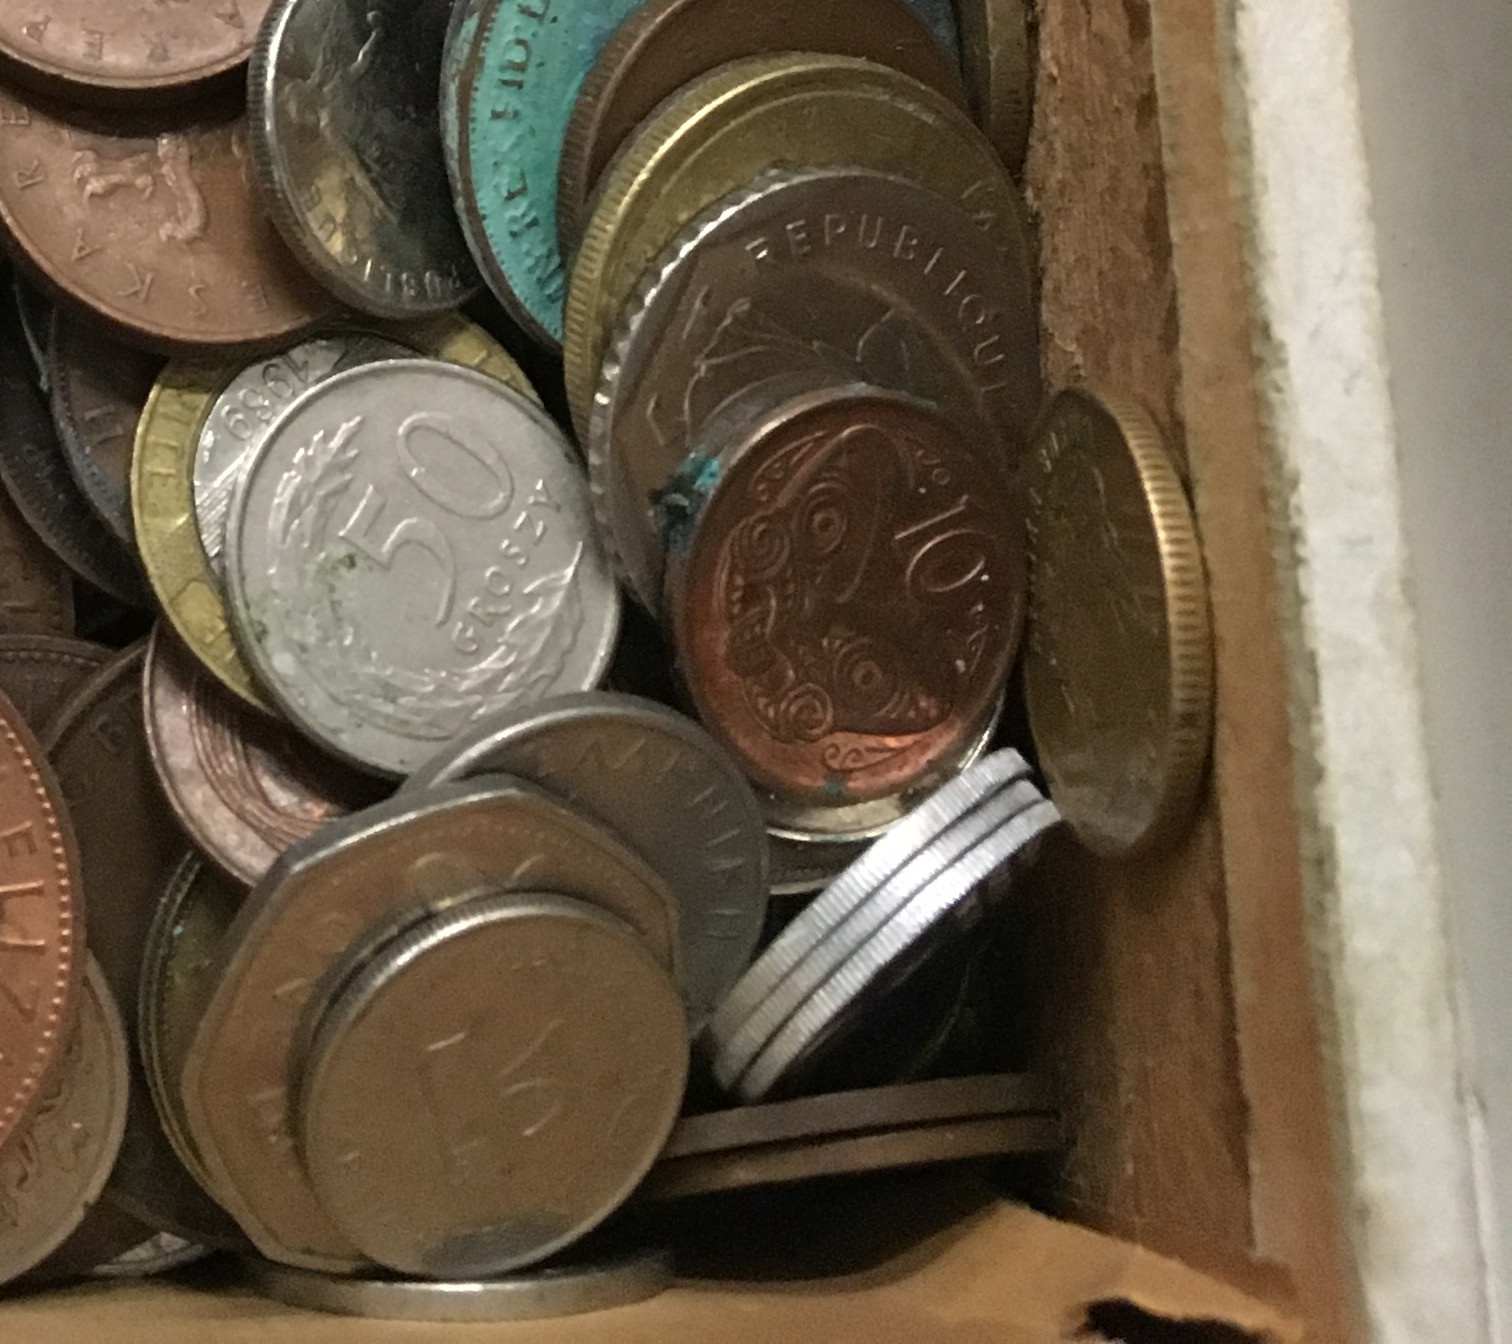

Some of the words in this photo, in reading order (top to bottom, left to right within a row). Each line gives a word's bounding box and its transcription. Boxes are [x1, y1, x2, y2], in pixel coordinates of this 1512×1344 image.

[220, 348, 314, 439] 1989
[337, 409, 517, 632] 50
[450, 475, 564, 657] GROSZY
